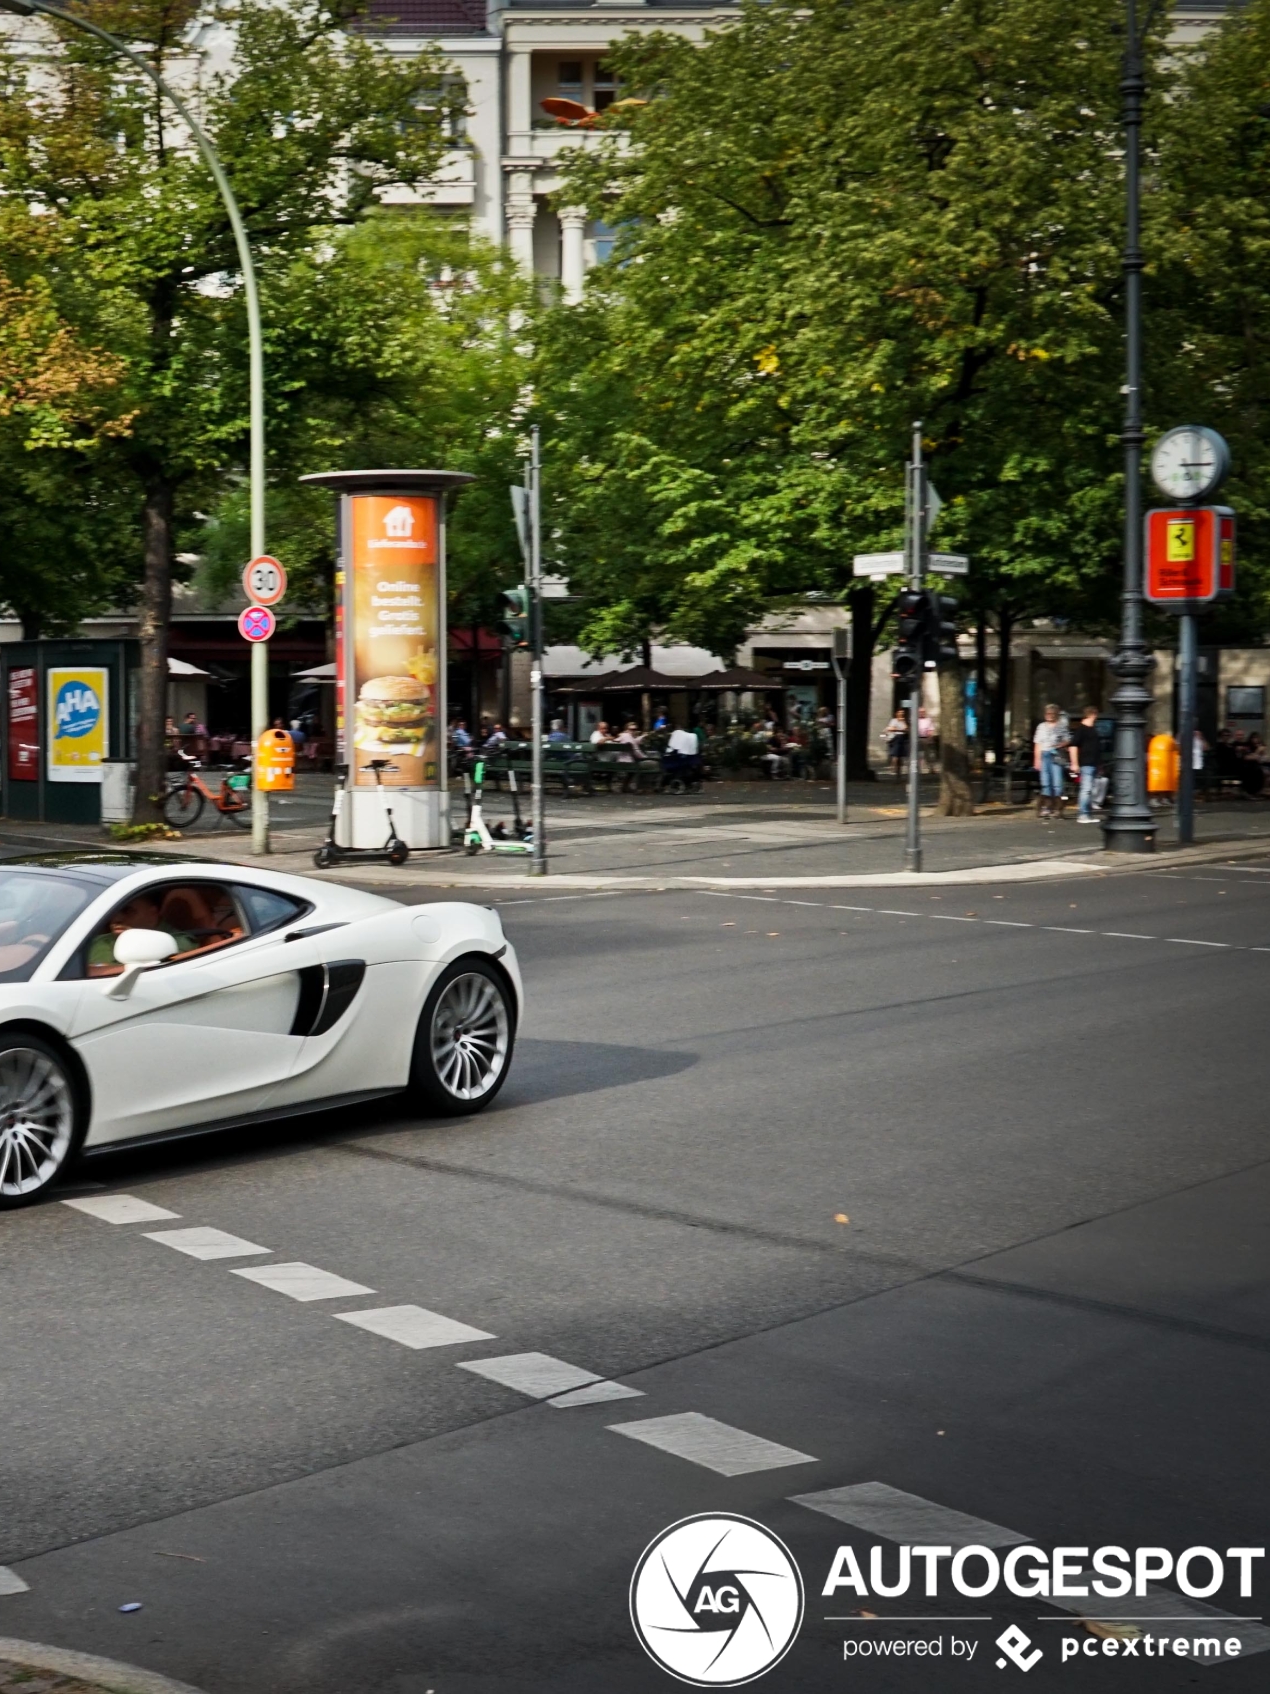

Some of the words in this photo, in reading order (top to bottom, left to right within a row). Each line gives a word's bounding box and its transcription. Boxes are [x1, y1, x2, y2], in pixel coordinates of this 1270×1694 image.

[255, 569, 279, 591] 30
[377, 581, 421, 592] Online
[371, 595, 424, 606] bestellt.
[378, 610, 420, 621] Gratis
[368, 624, 427, 637] geliefert.
[56, 689, 101, 725] AHA
